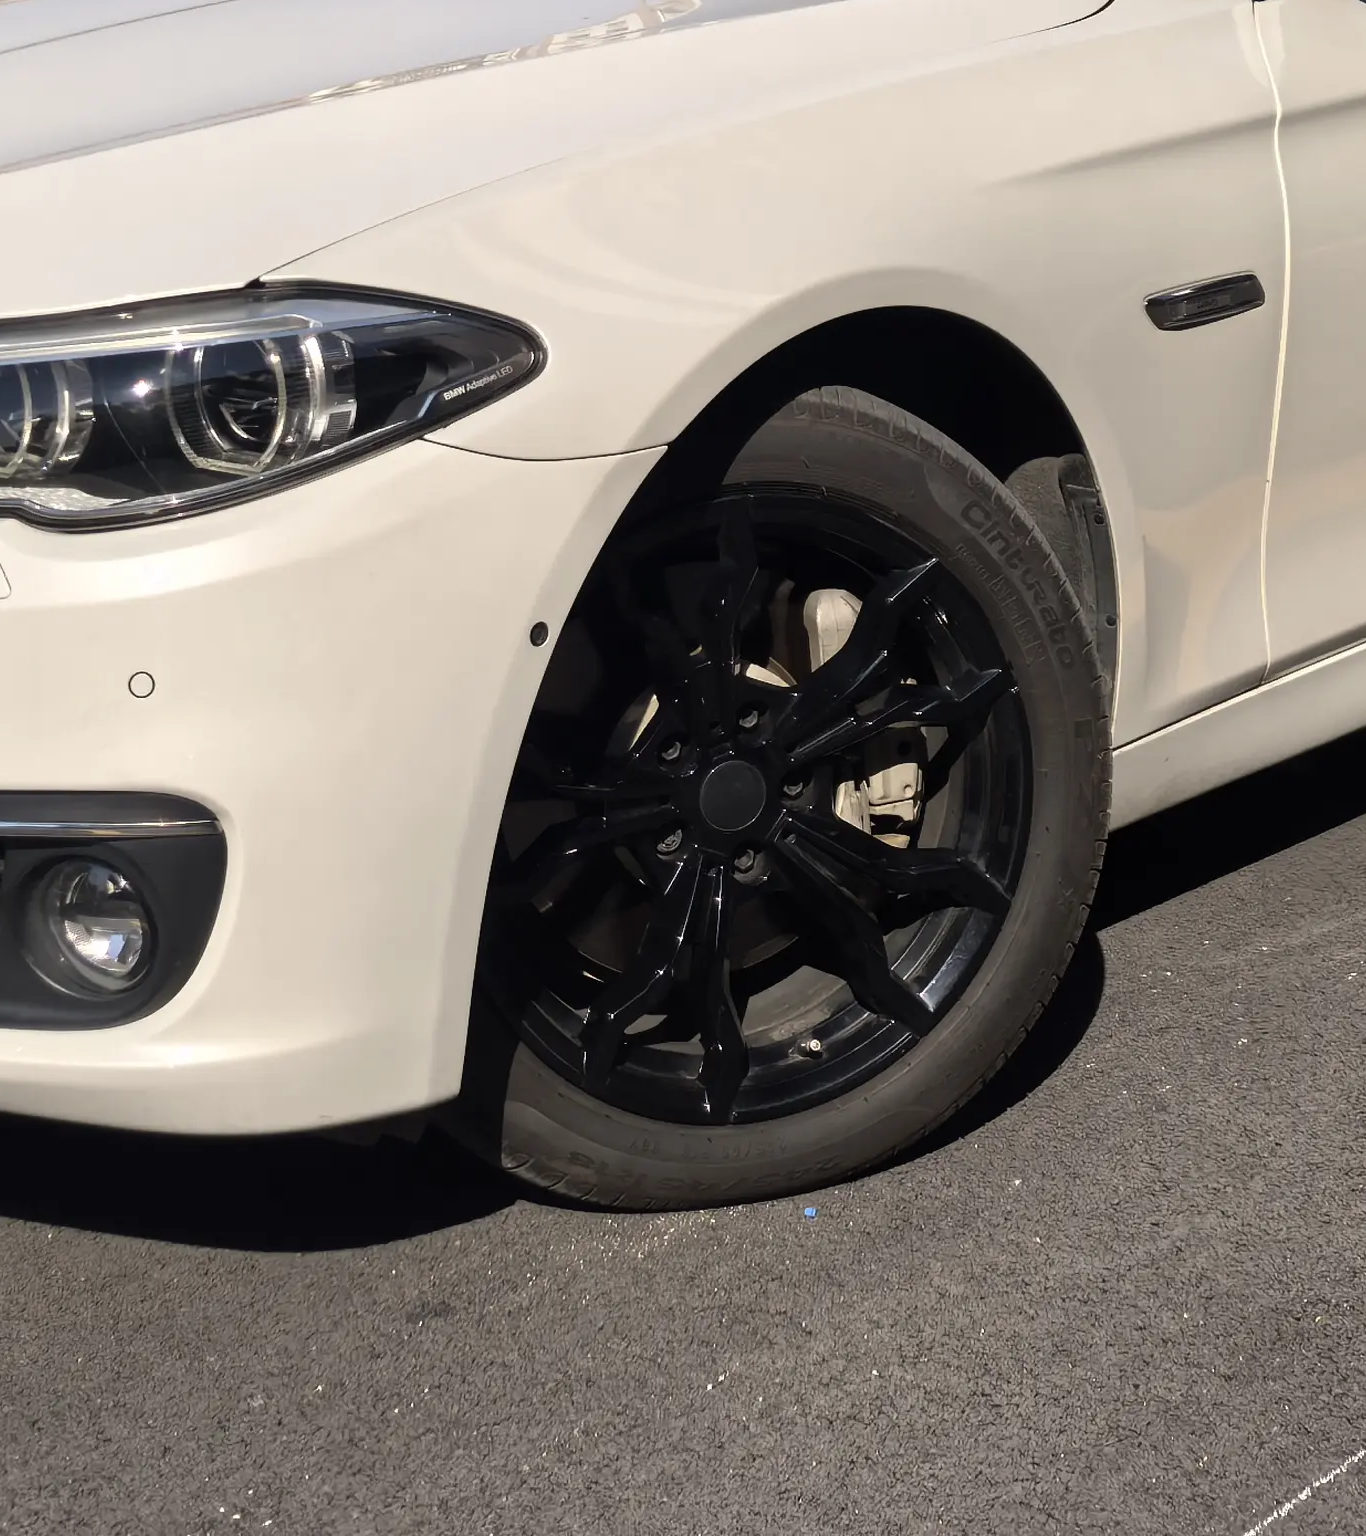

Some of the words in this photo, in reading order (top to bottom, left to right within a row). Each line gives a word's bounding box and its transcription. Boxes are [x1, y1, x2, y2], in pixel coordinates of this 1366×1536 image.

[443, 385, 466, 401] BMW
[466, 373, 498, 391] Adaptive
[496, 365, 514, 378] LED
[960, 498, 1074, 671] Cinturato
